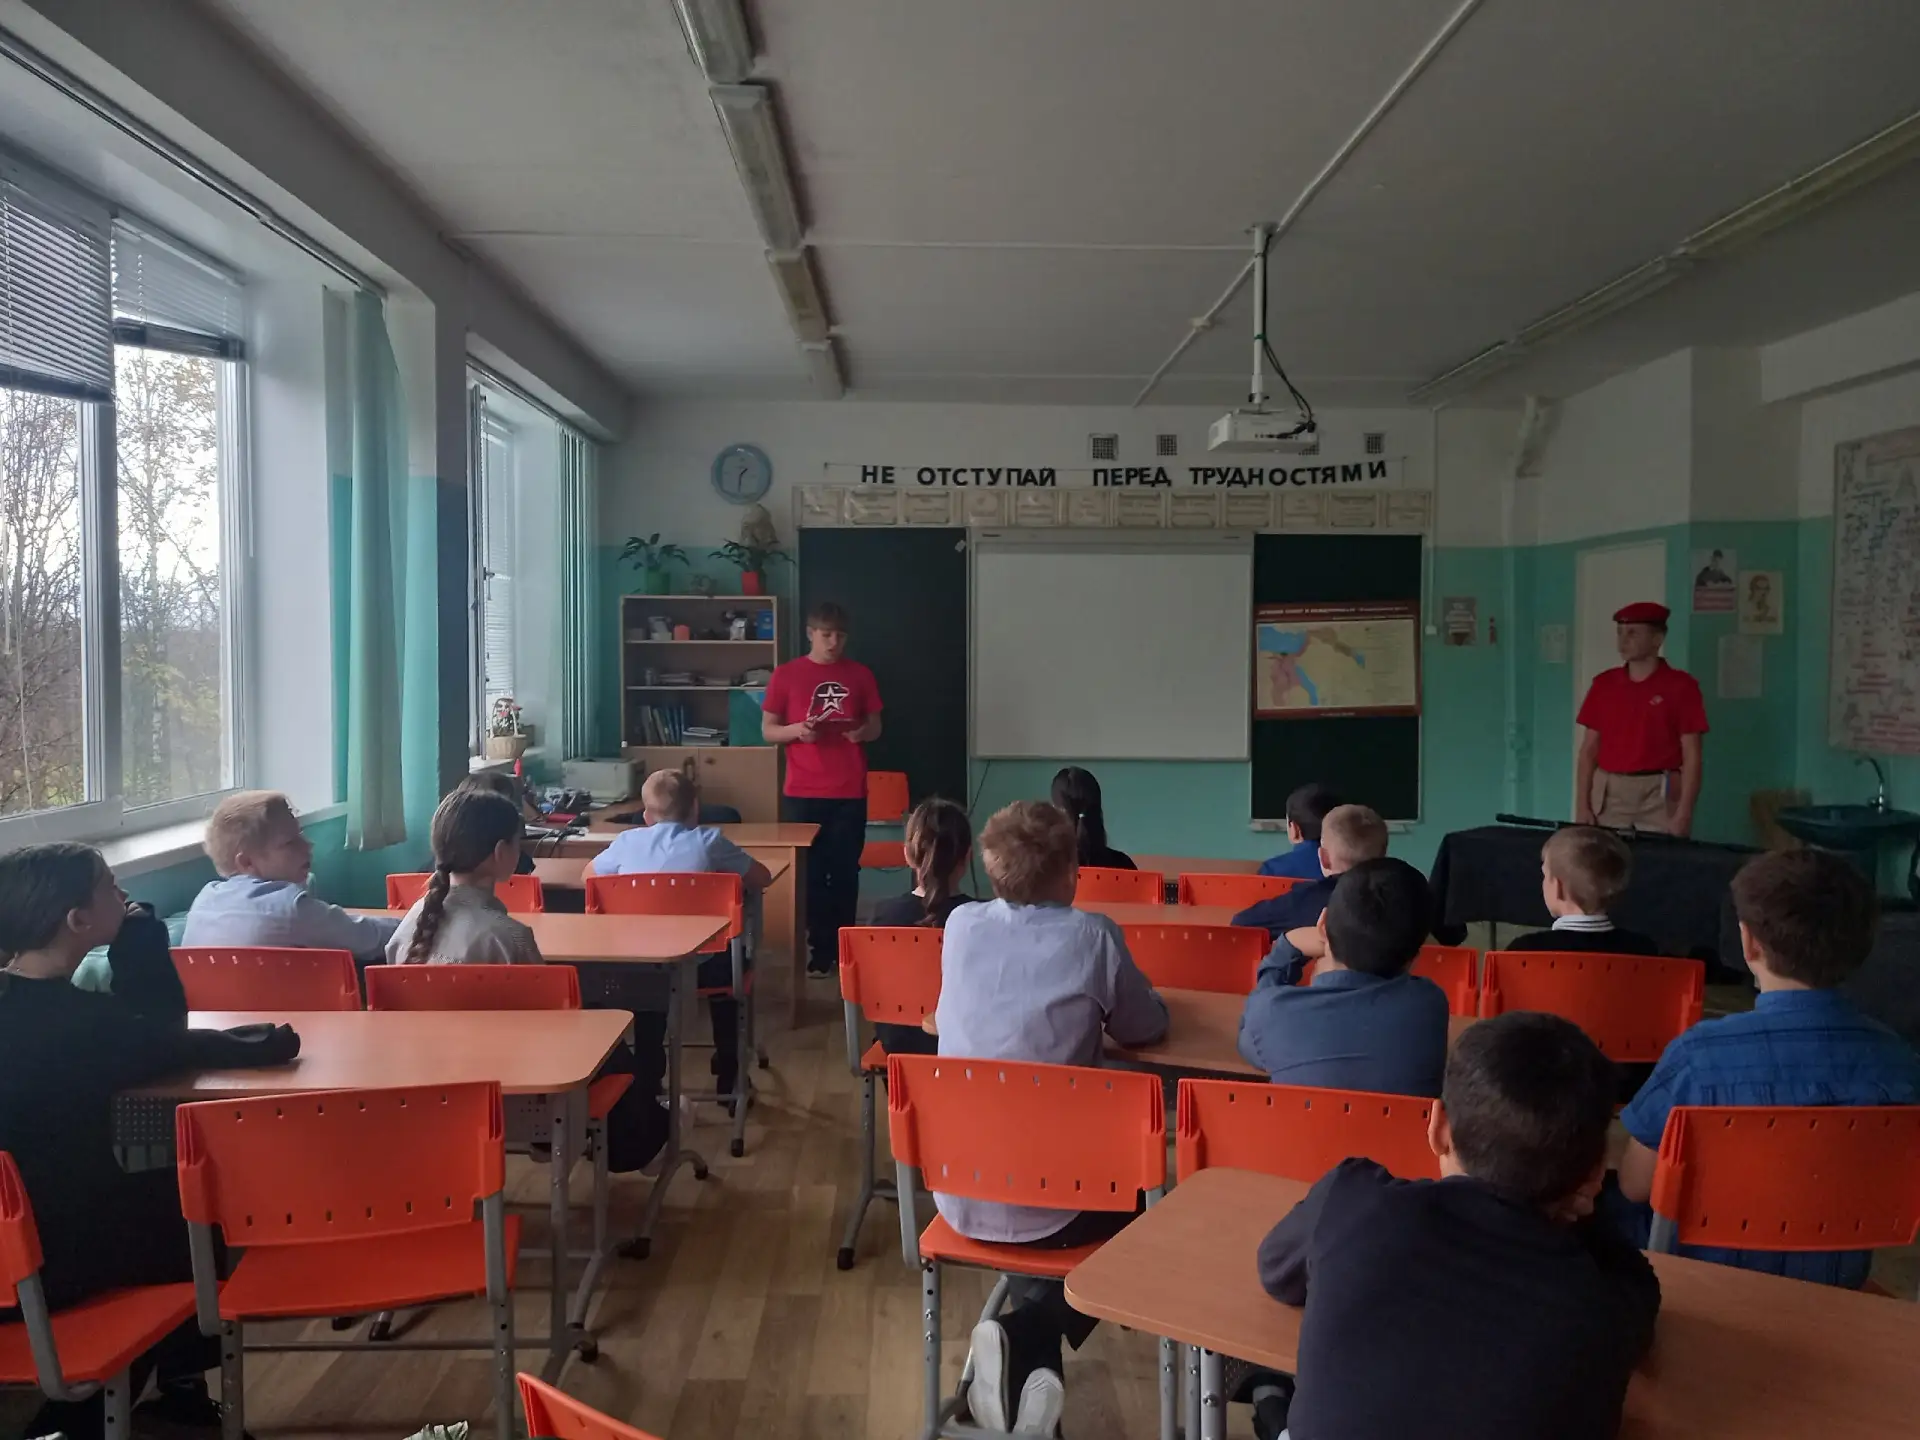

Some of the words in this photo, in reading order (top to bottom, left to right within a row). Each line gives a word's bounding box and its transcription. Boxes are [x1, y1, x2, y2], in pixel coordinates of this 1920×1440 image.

[861, 465, 895, 484] НЕ
[917, 466, 1056, 486] ОТСТУПАЙ
[1093, 466, 1172, 487] ПЕРЕД
[1188, 460, 1387, 488] ТРУДНОСТЯМИ
